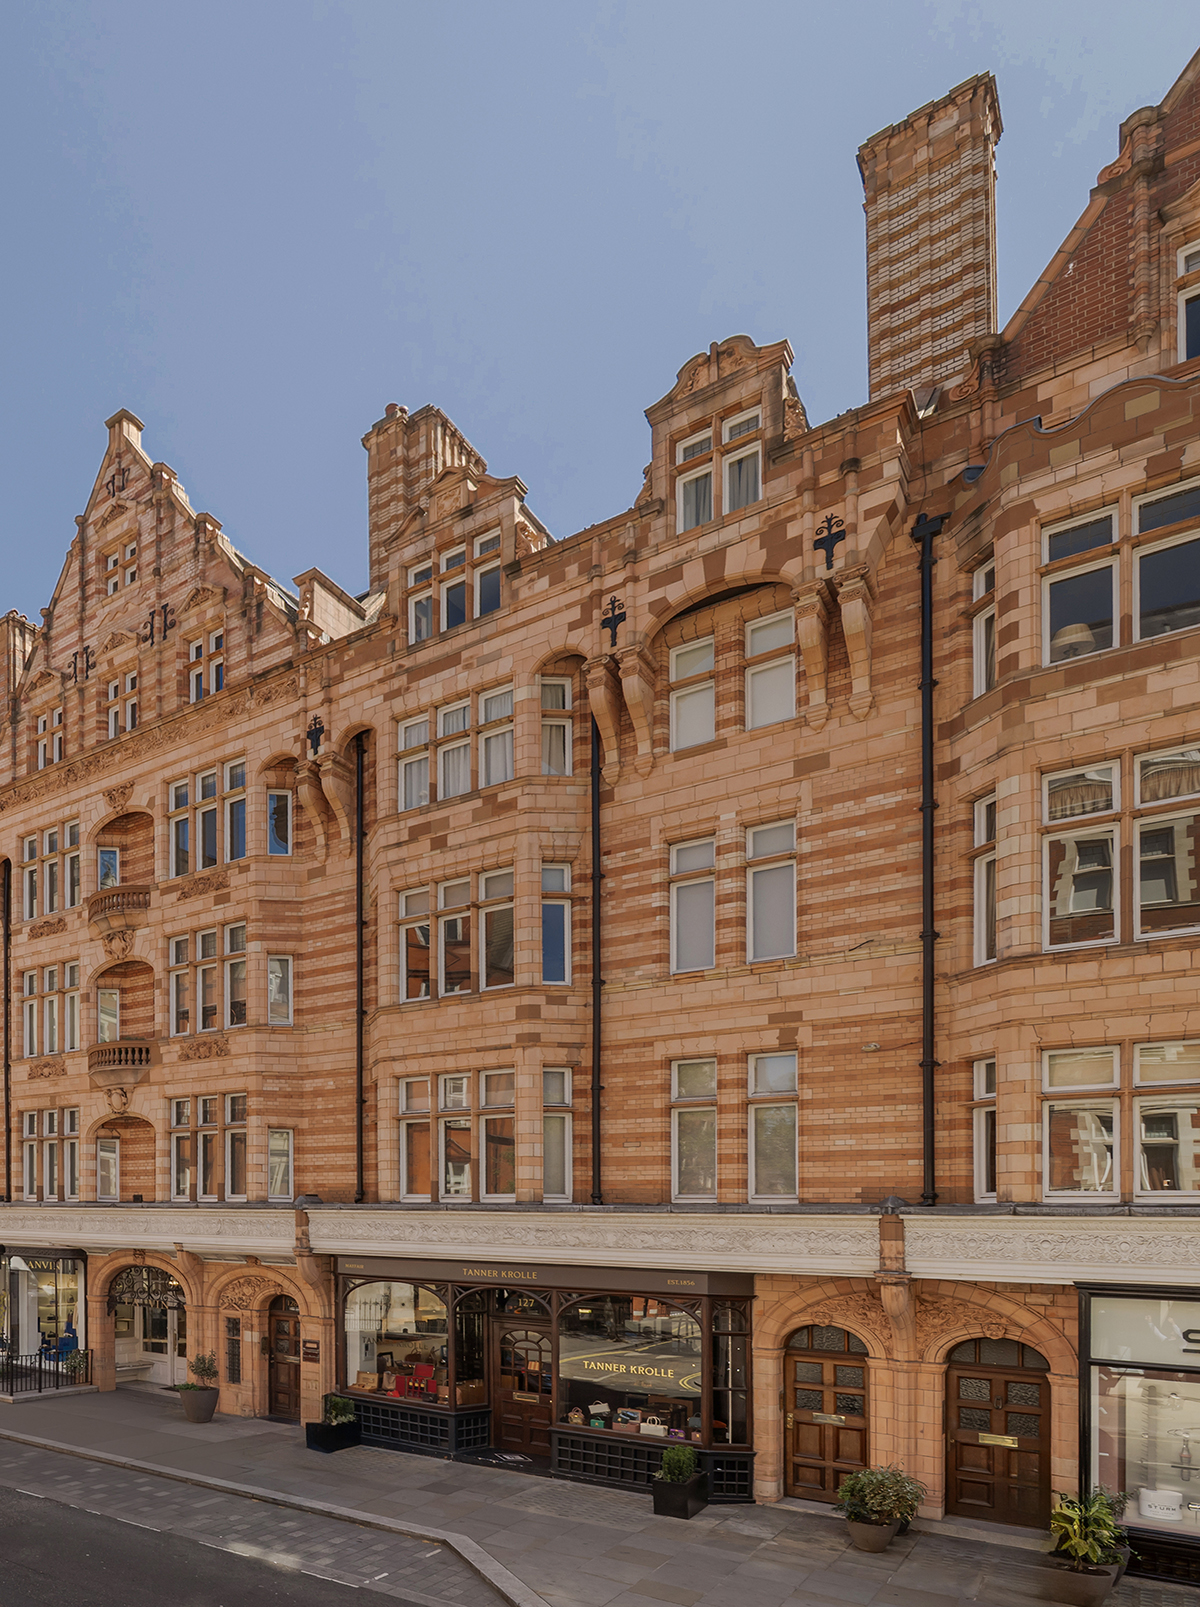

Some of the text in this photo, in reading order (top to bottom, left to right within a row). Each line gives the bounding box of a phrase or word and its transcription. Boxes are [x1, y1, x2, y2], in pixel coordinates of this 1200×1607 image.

[462, 1268, 538, 1279] TANNER KROLLE
[518, 1298, 535, 1307] 127
[583, 1361, 674, 1378] TANNER KROLLE
